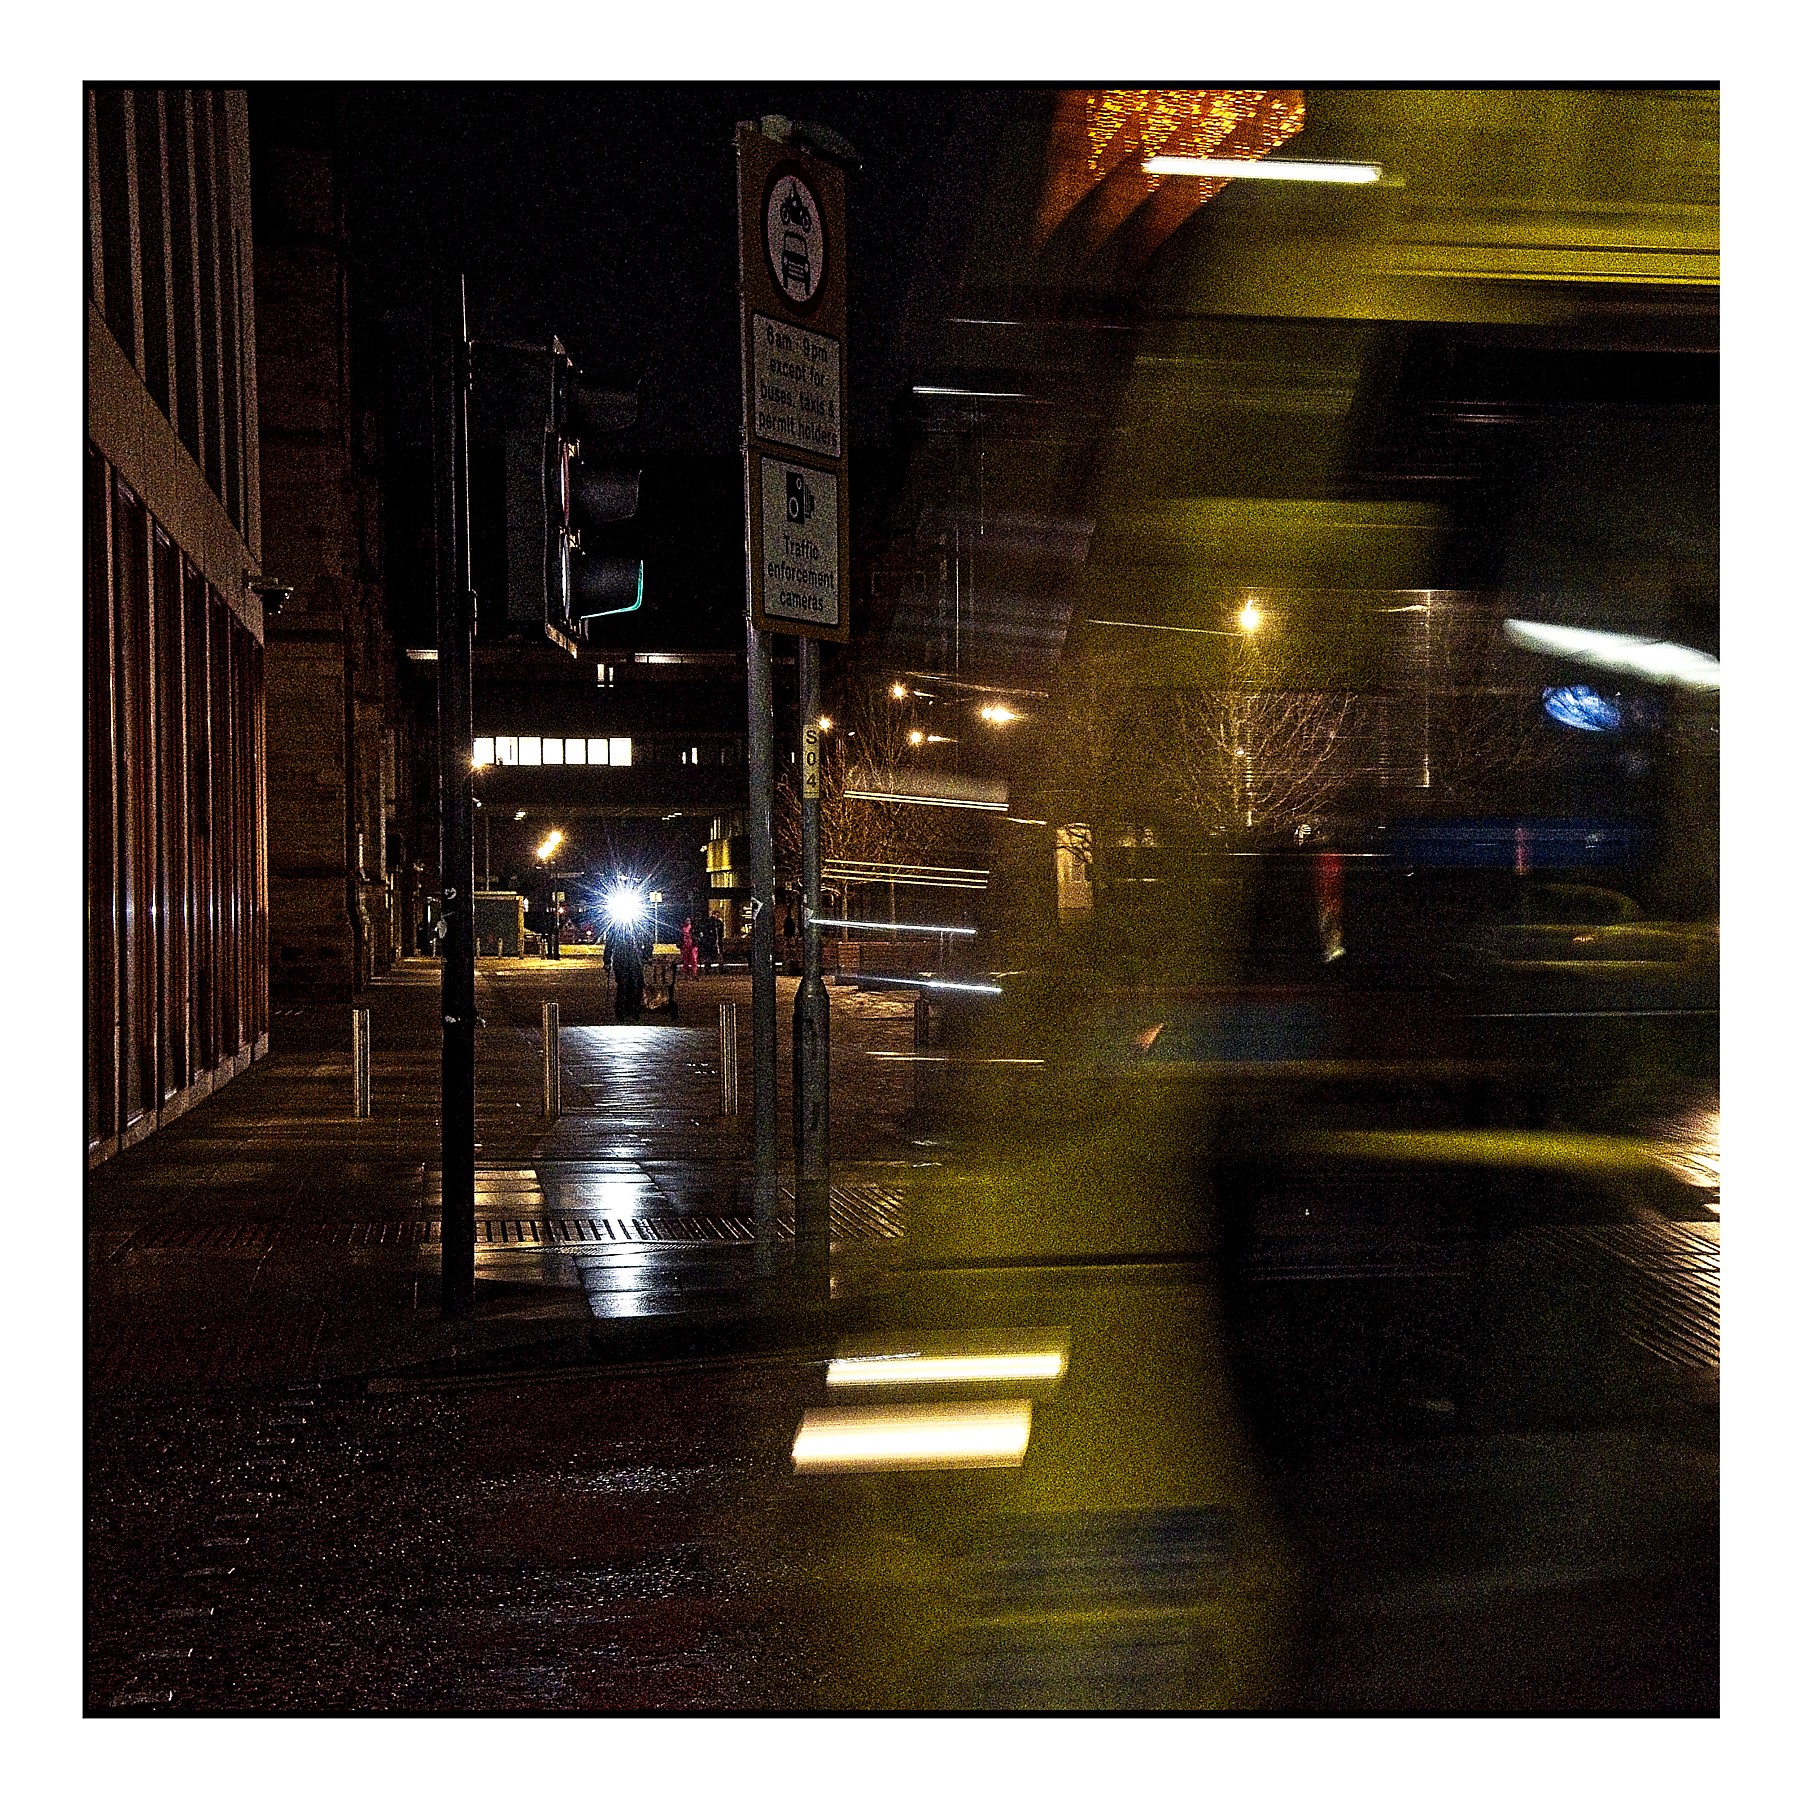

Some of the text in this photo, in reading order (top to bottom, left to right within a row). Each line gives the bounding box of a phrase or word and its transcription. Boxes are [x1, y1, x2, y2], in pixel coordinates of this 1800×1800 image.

[770, 358, 826, 387] except for
[800, 391, 825, 416] taxis
[828, 400, 835, 419] &
[758, 412, 838, 447] permit holders
[784, 535, 819, 560] Traffic
[767, 561, 834, 589] enforcement
[780, 591, 823, 612] cameras
